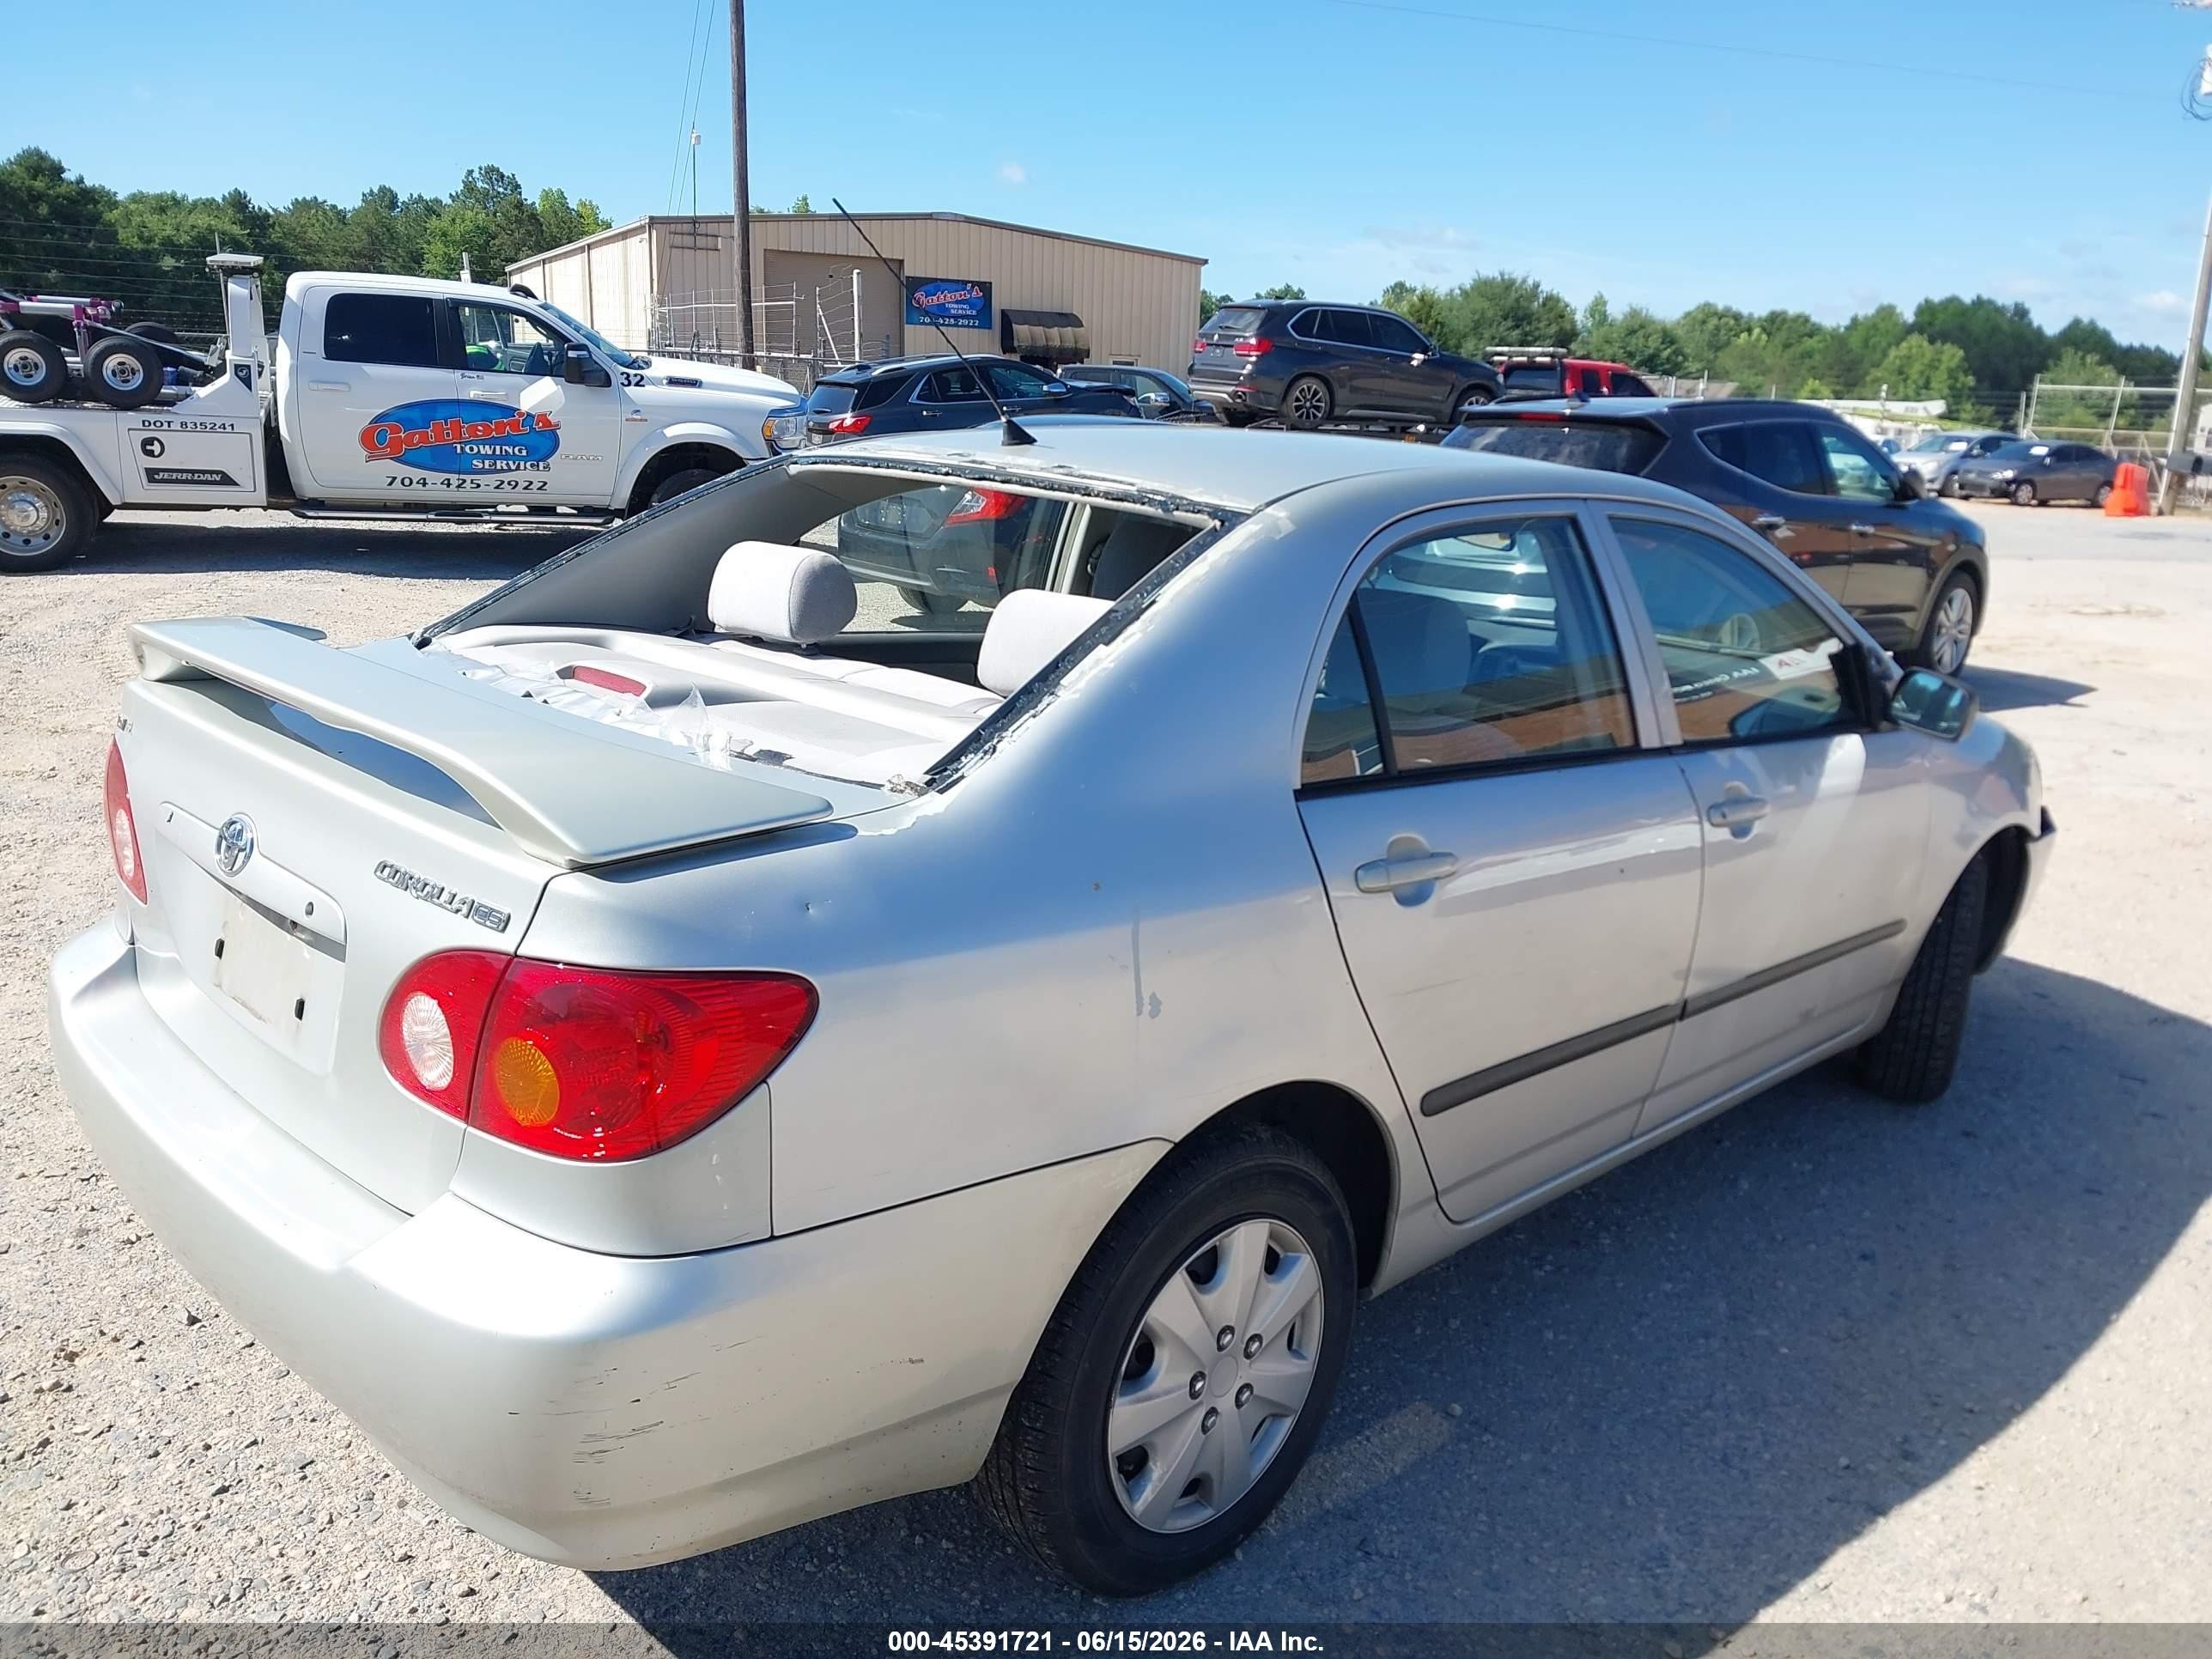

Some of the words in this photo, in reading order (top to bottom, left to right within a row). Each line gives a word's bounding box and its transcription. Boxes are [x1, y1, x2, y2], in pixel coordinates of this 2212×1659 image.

[912, 283, 983, 308] Gatton's
[620, 372, 645, 387] 32
[142, 420, 173, 428] DOT
[179, 421, 234, 431] 835241
[359, 410, 561, 463] Gatton's
[453, 444, 527, 456] TOWING
[561, 453, 603, 462] RAM
[471, 459, 550, 471] SERVICE
[386, 476, 549, 491] 704-425-2922
[374, 859, 475, 920] COROLLA
